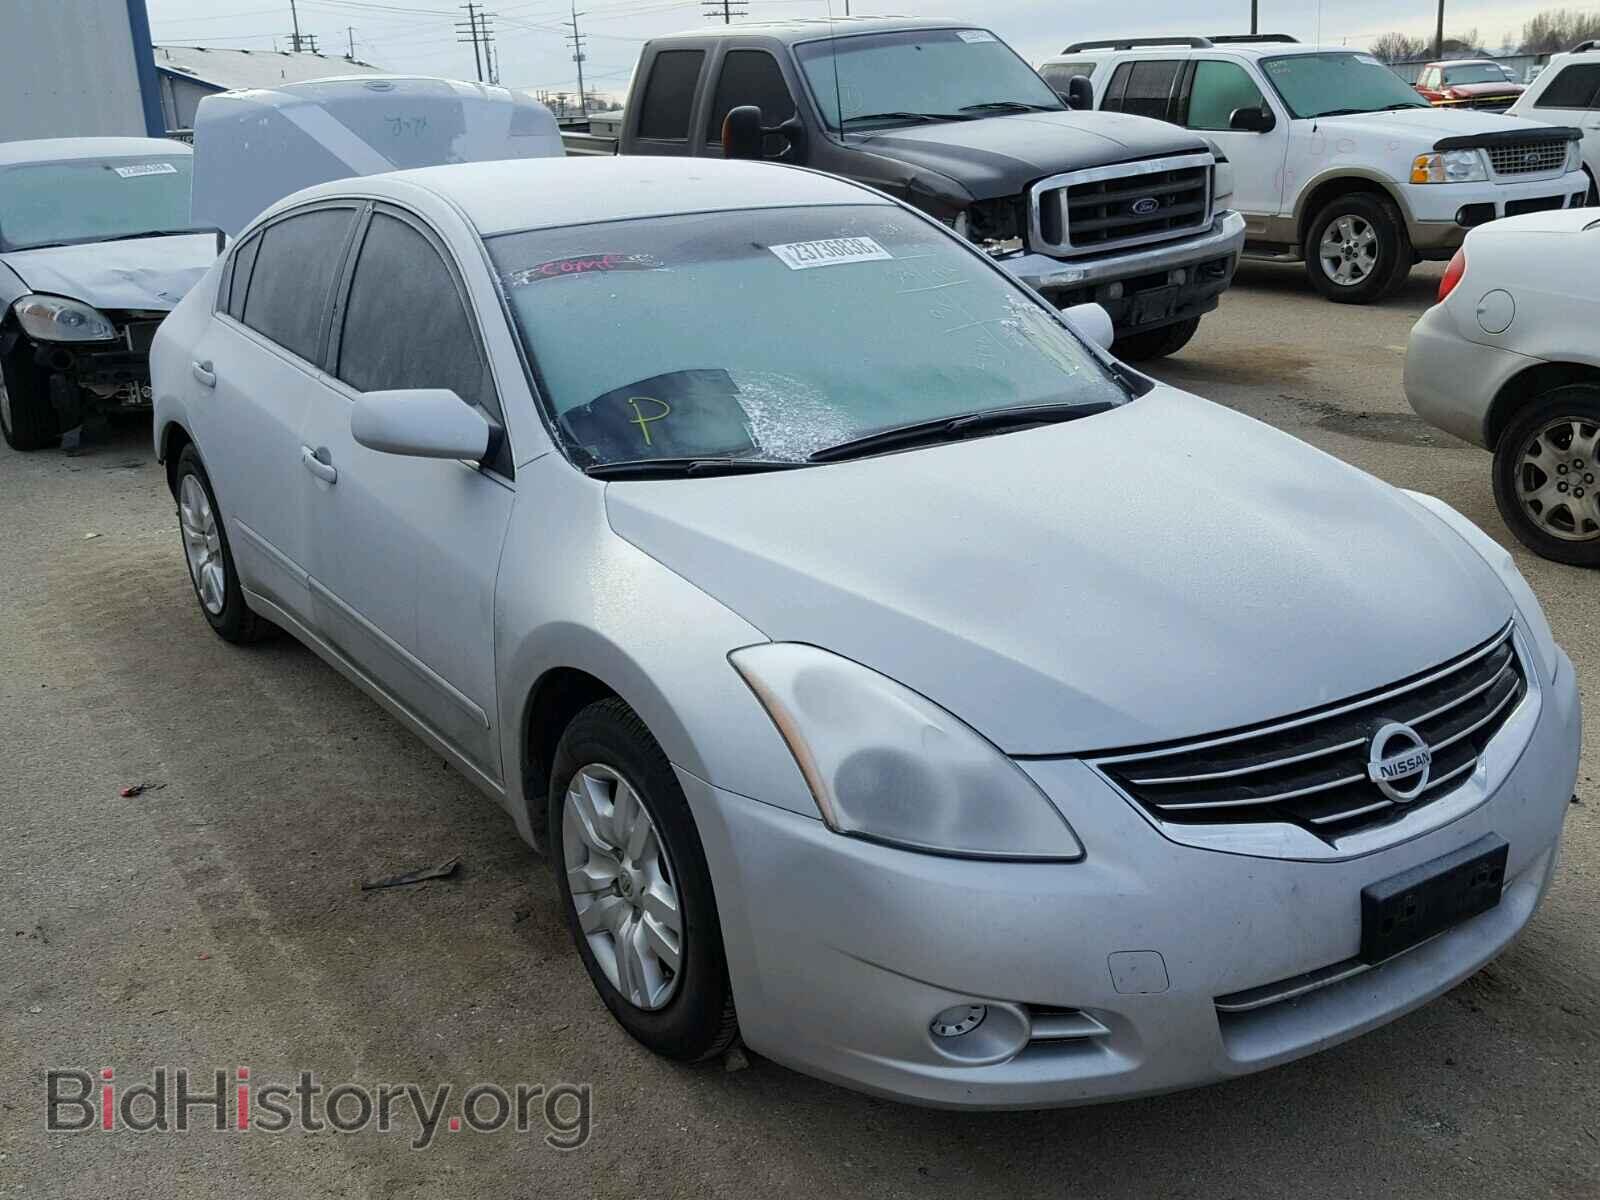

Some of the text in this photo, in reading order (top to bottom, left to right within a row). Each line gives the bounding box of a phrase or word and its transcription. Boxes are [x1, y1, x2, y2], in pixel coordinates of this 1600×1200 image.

[785, 238, 873, 261] 23736838
[628, 396, 671, 446] P
[1380, 752, 1430, 778] NISSAN
